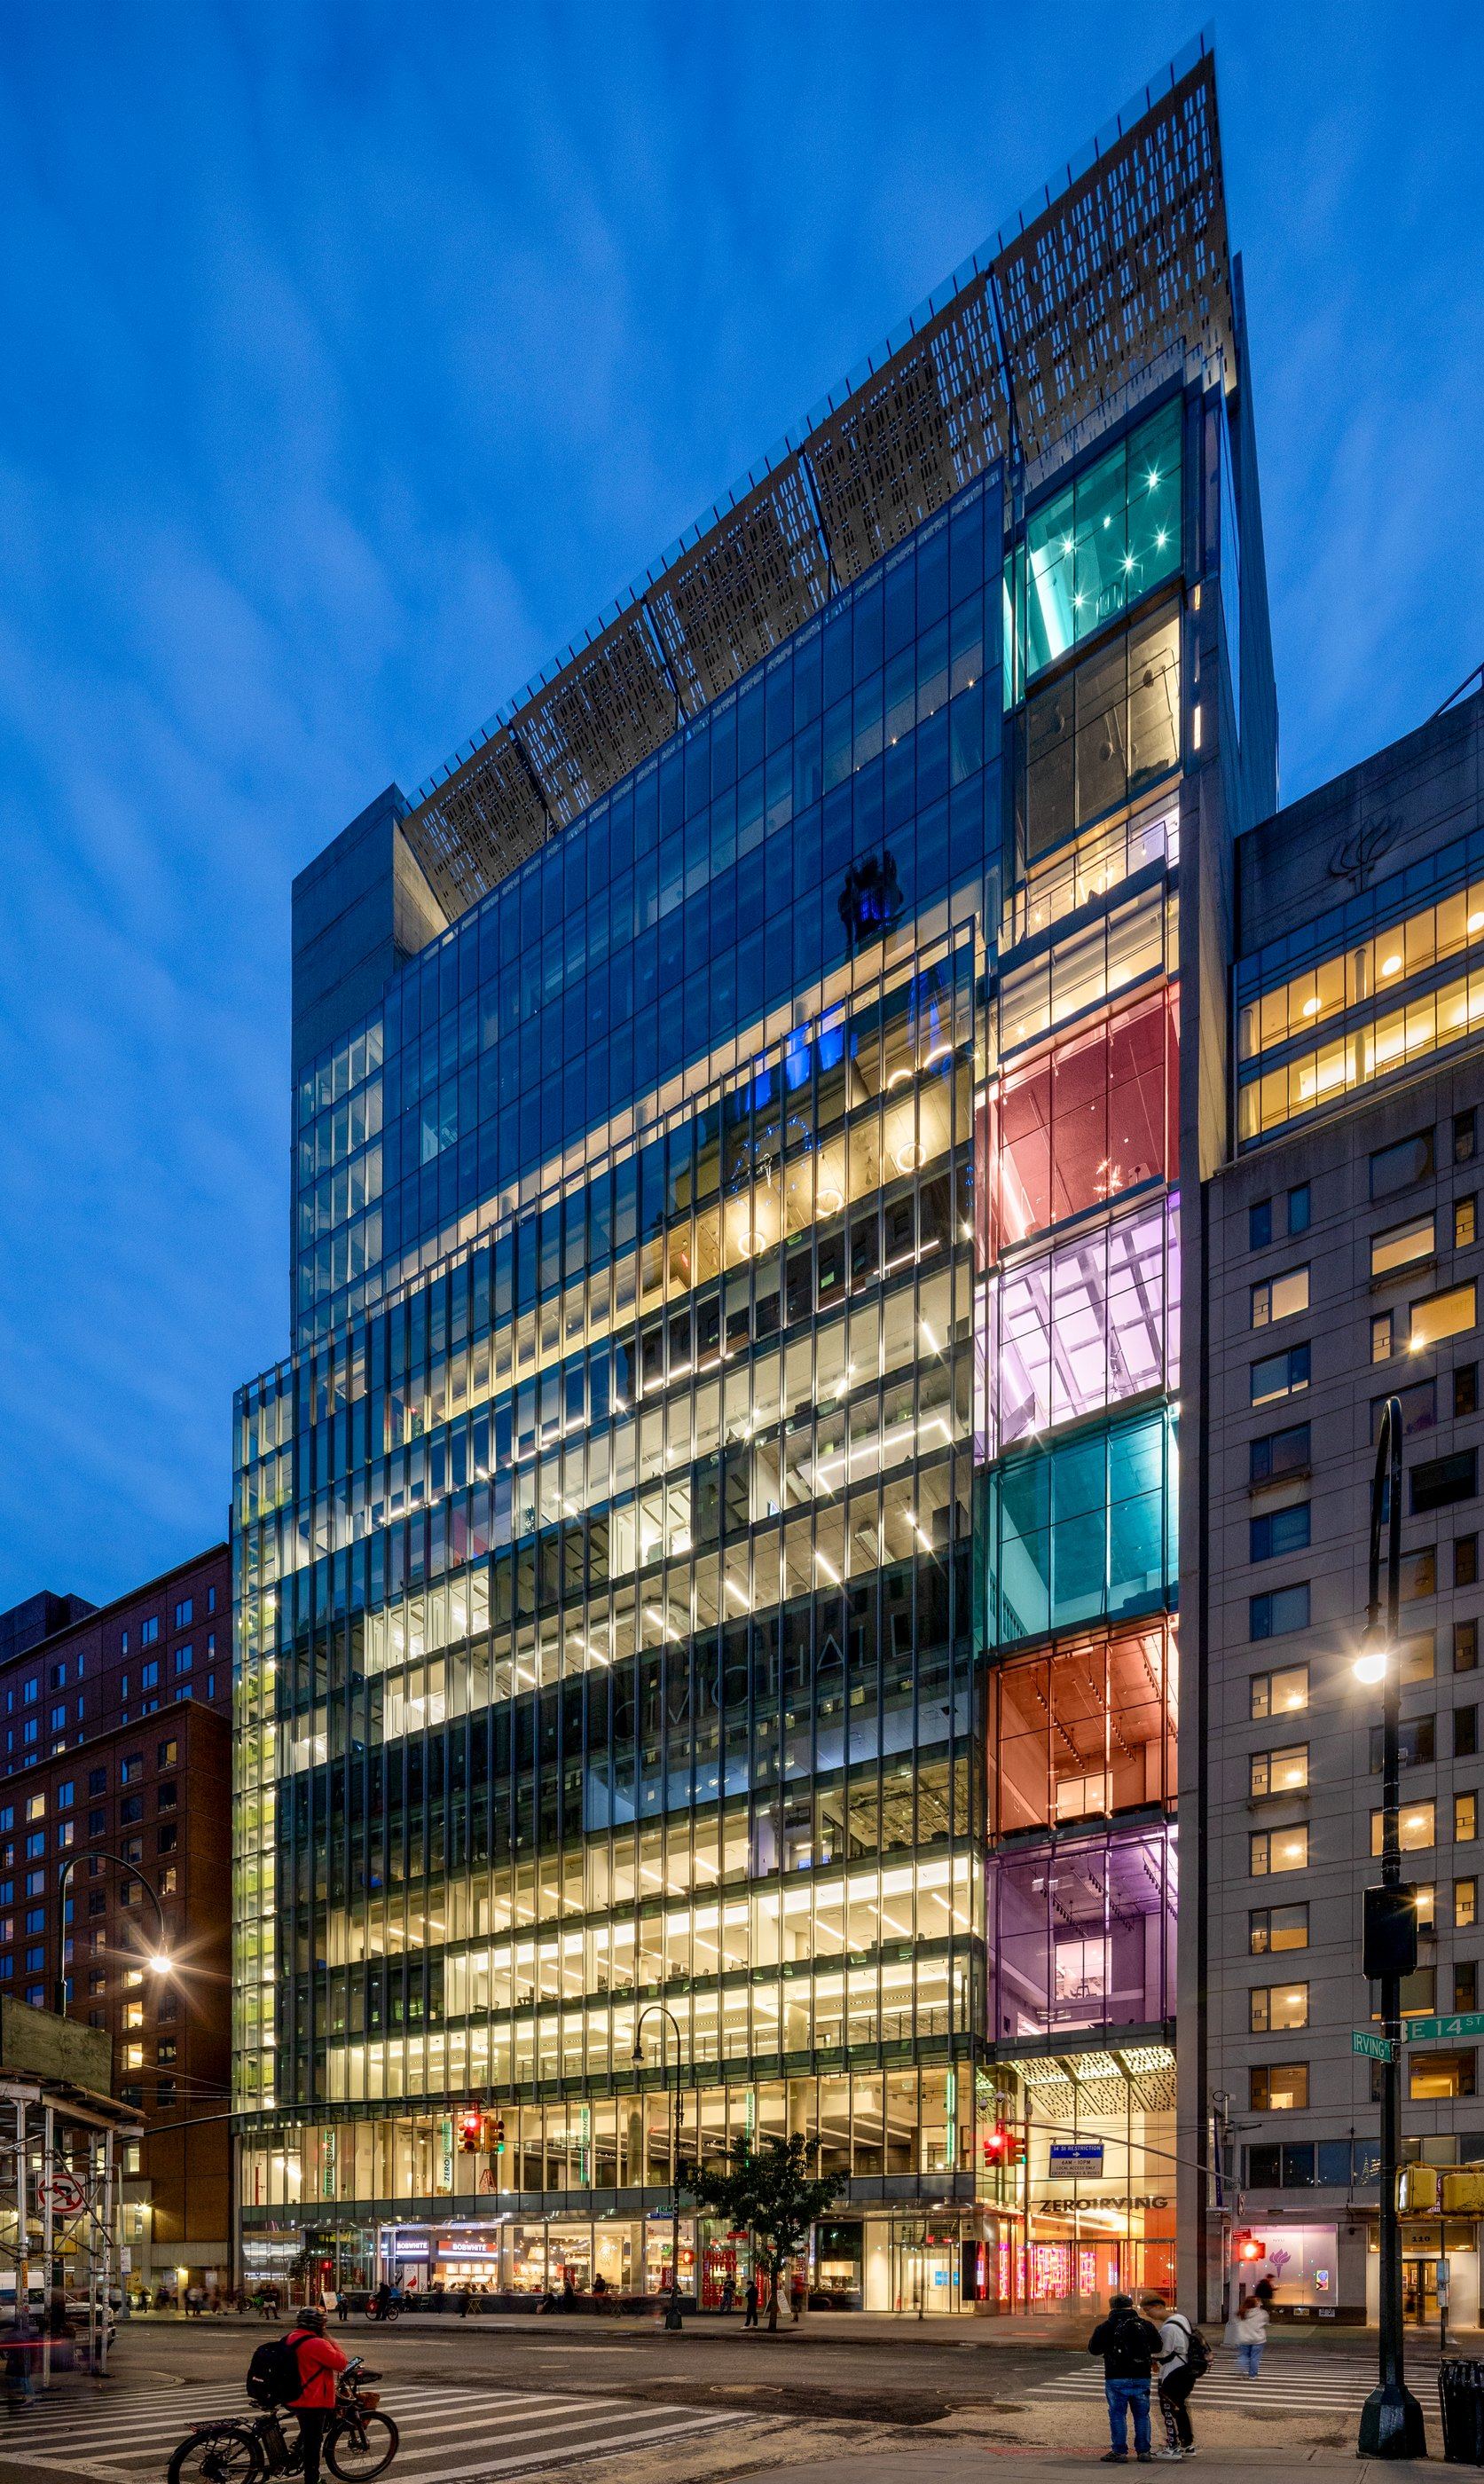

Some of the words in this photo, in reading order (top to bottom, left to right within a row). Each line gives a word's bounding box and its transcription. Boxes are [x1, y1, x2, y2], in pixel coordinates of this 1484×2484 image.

[614, 1664, 750, 1741] CIVIC
[768, 1613, 915, 1695] HALL
[1411, 2022, 1425, 2039] E
[1435, 2018, 1463, 2037] 14
[1465, 2016, 1482, 2026] ST
[1354, 2032, 1385, 2058] IRVING
[1040, 2197, 1169, 2213] ZEROIRVING
[452, 2243, 487, 2252] BOBWHITE
